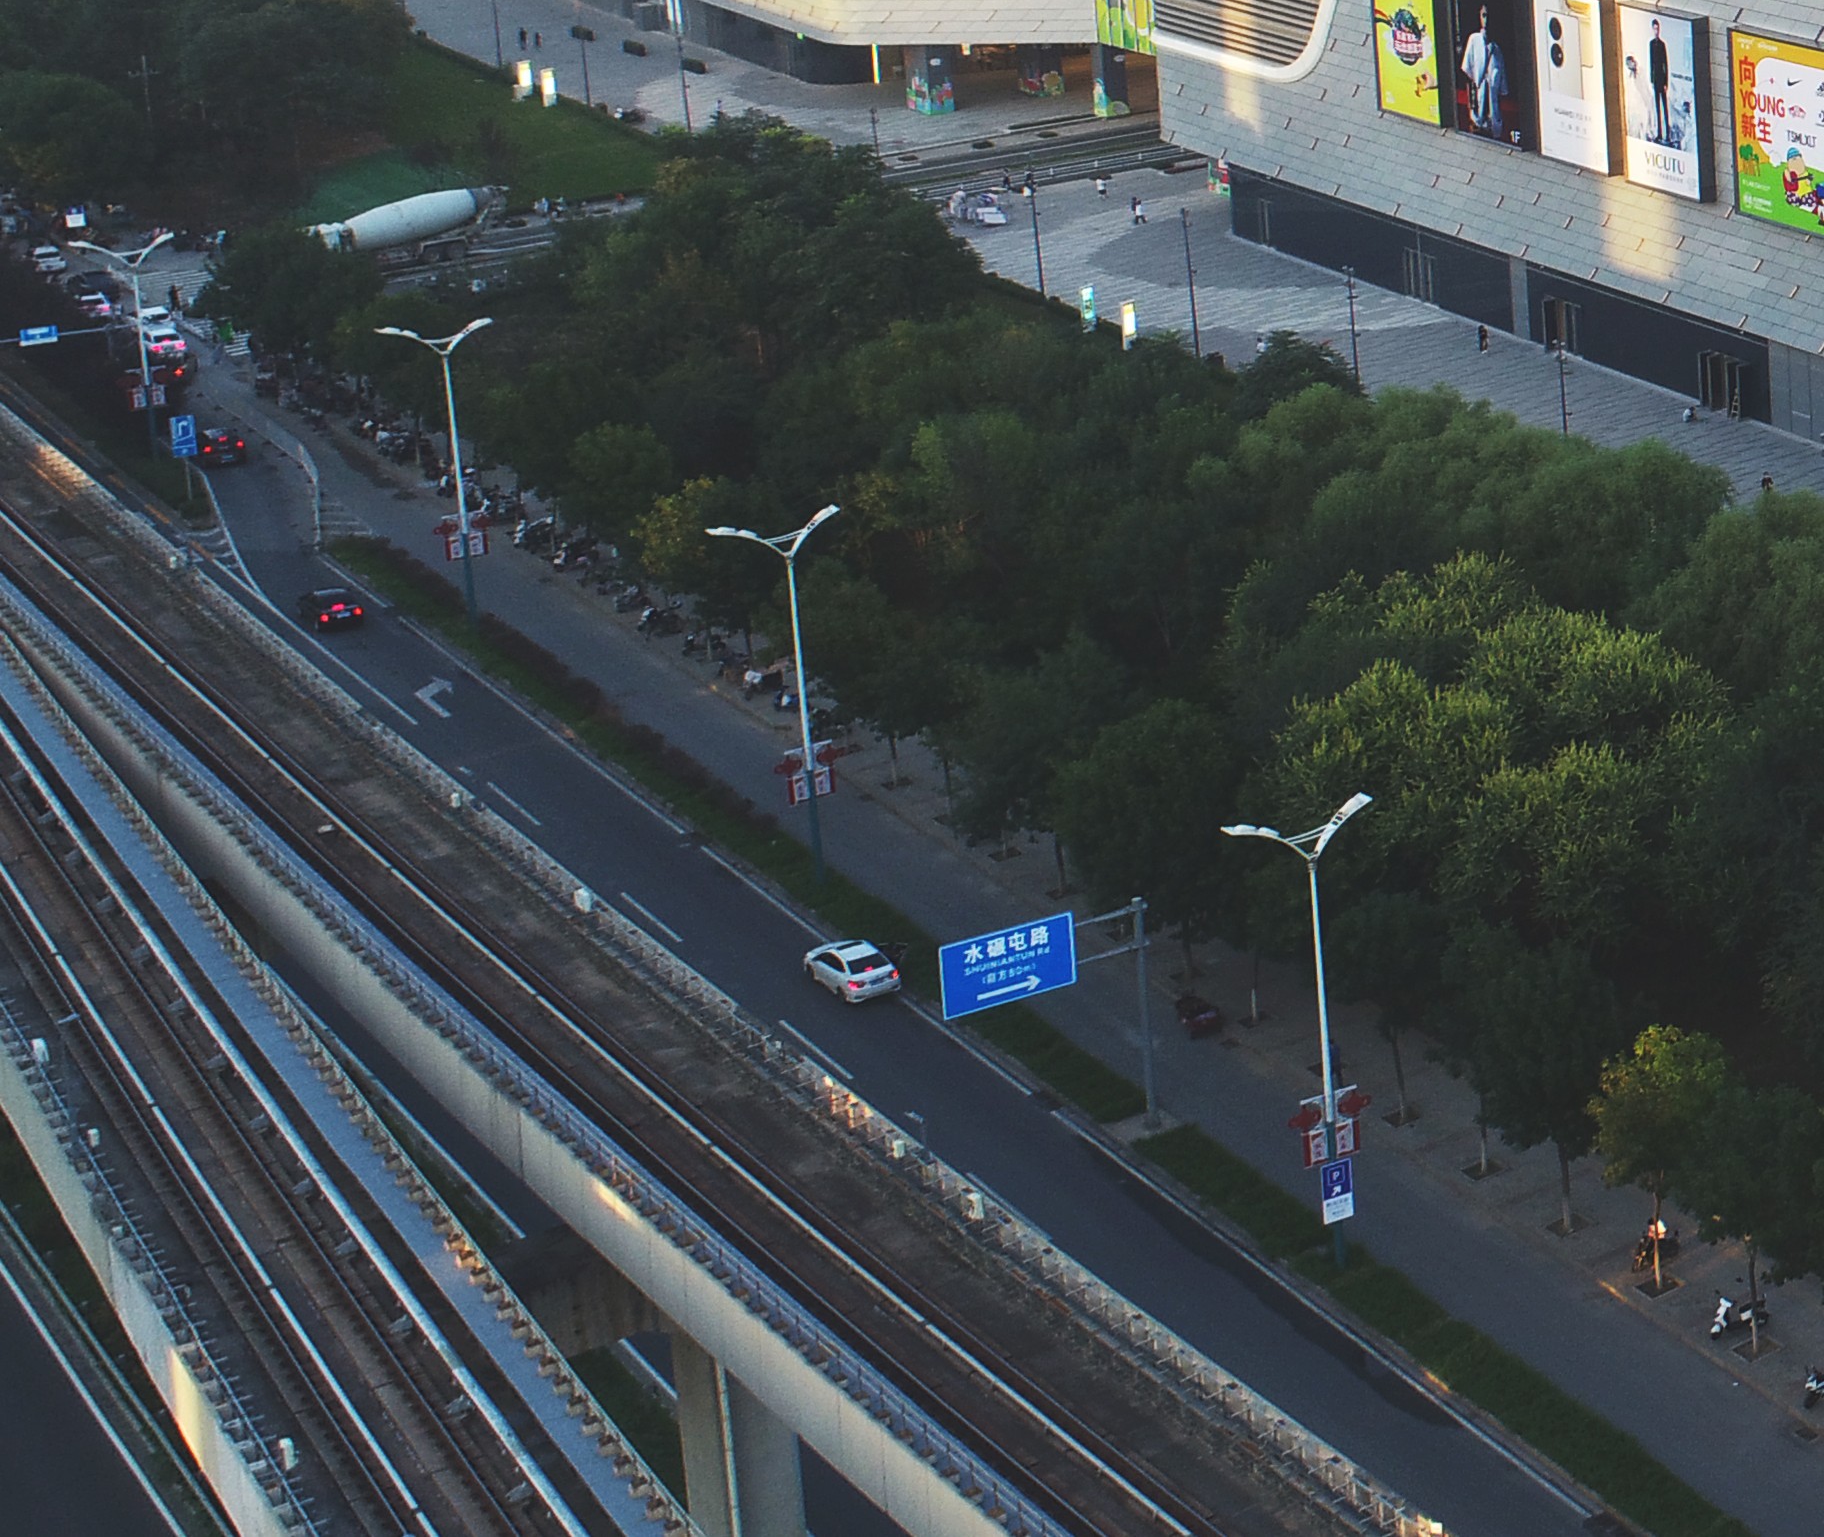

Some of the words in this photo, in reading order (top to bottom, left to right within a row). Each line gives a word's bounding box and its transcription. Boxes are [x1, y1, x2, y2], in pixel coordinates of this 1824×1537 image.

[1739, 56, 1756, 88] 向
[1740, 89, 1786, 118] YOUNG
[1741, 113, 1773, 144] 新生
[1644, 151, 1686, 175] VICUTU
